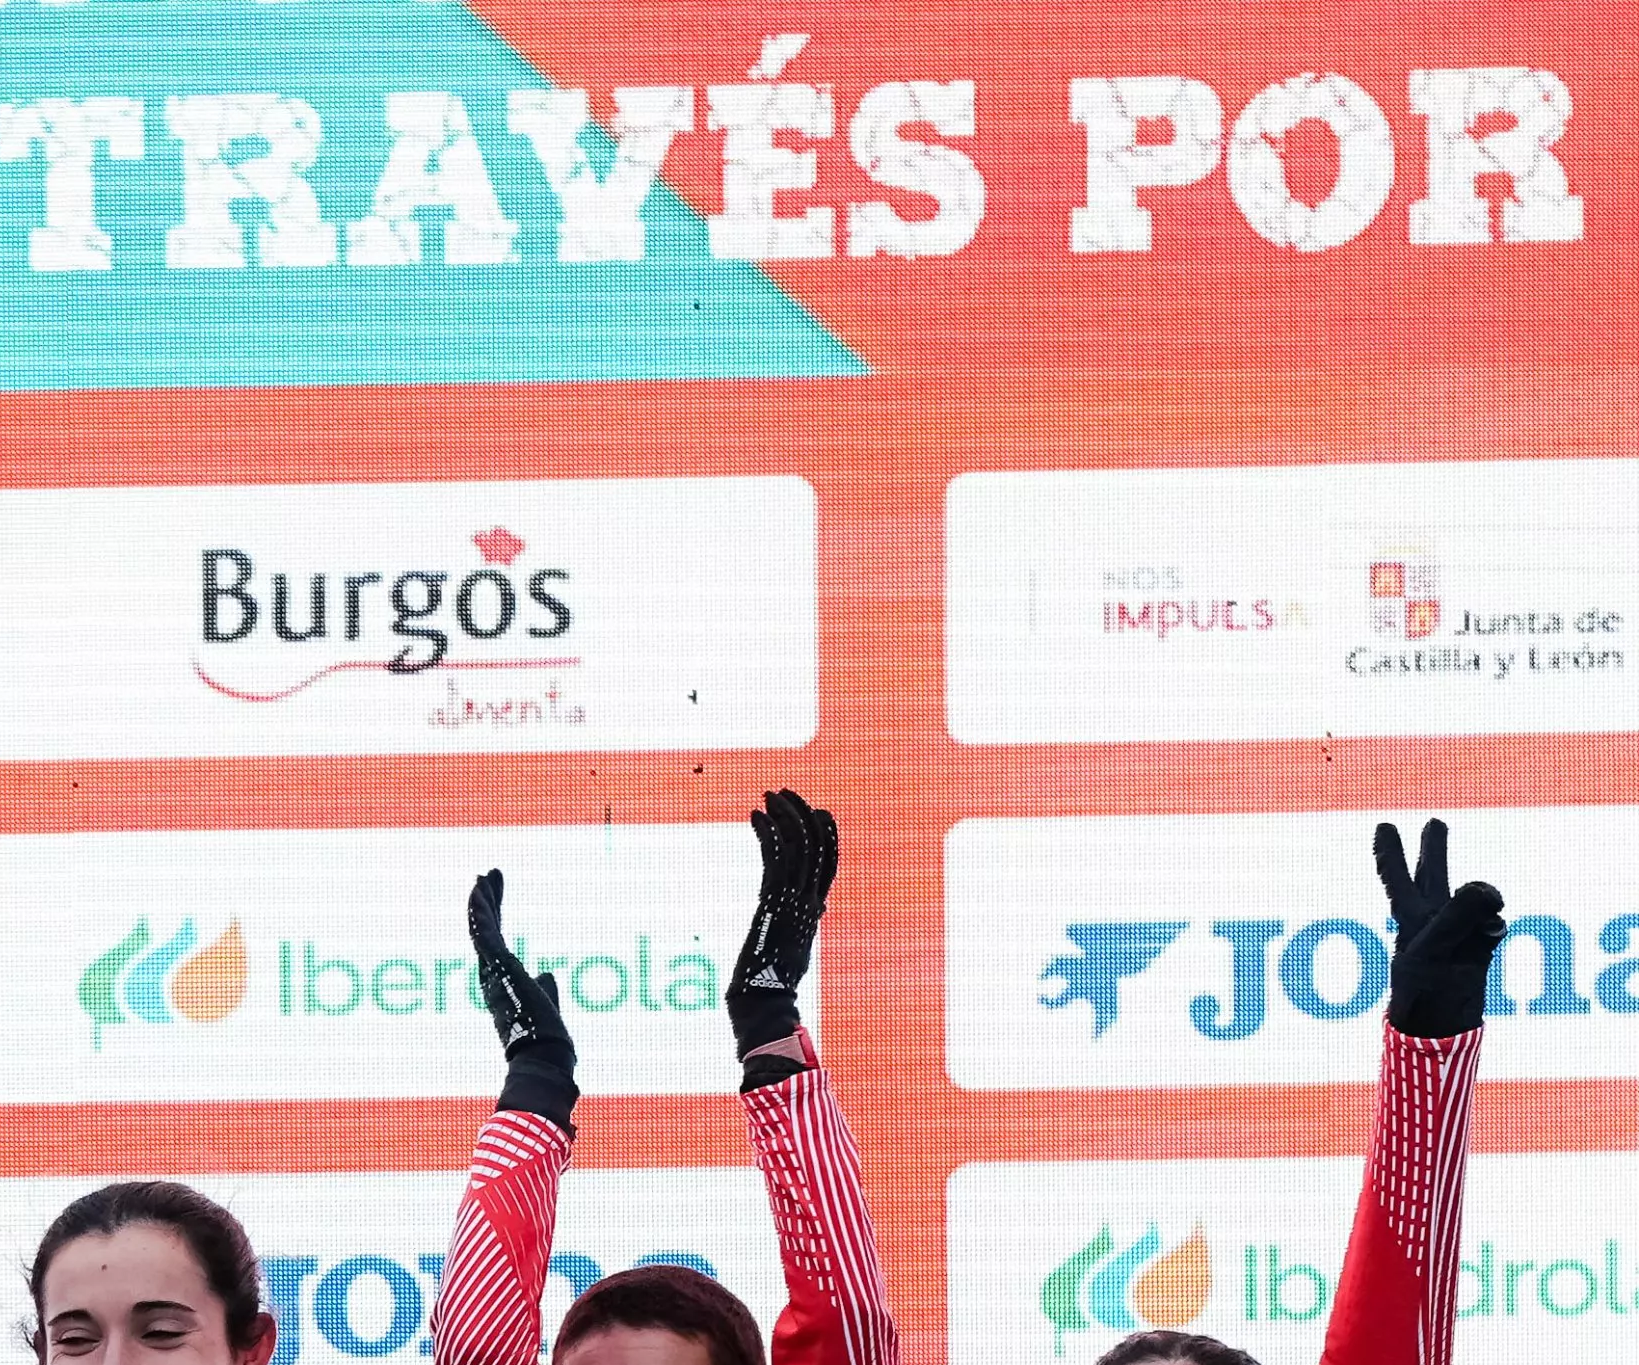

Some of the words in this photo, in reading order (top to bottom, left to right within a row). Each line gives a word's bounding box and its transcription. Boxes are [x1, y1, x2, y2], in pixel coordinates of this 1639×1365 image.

[1069, 66, 1586, 254] POR
[1454, 608, 1564, 635] Junta
[1574, 606, 1624, 633] de
[1346, 646, 1481, 675] Castilla
[1493, 651, 1515, 680] y
[1529, 642, 1625, 672] León
